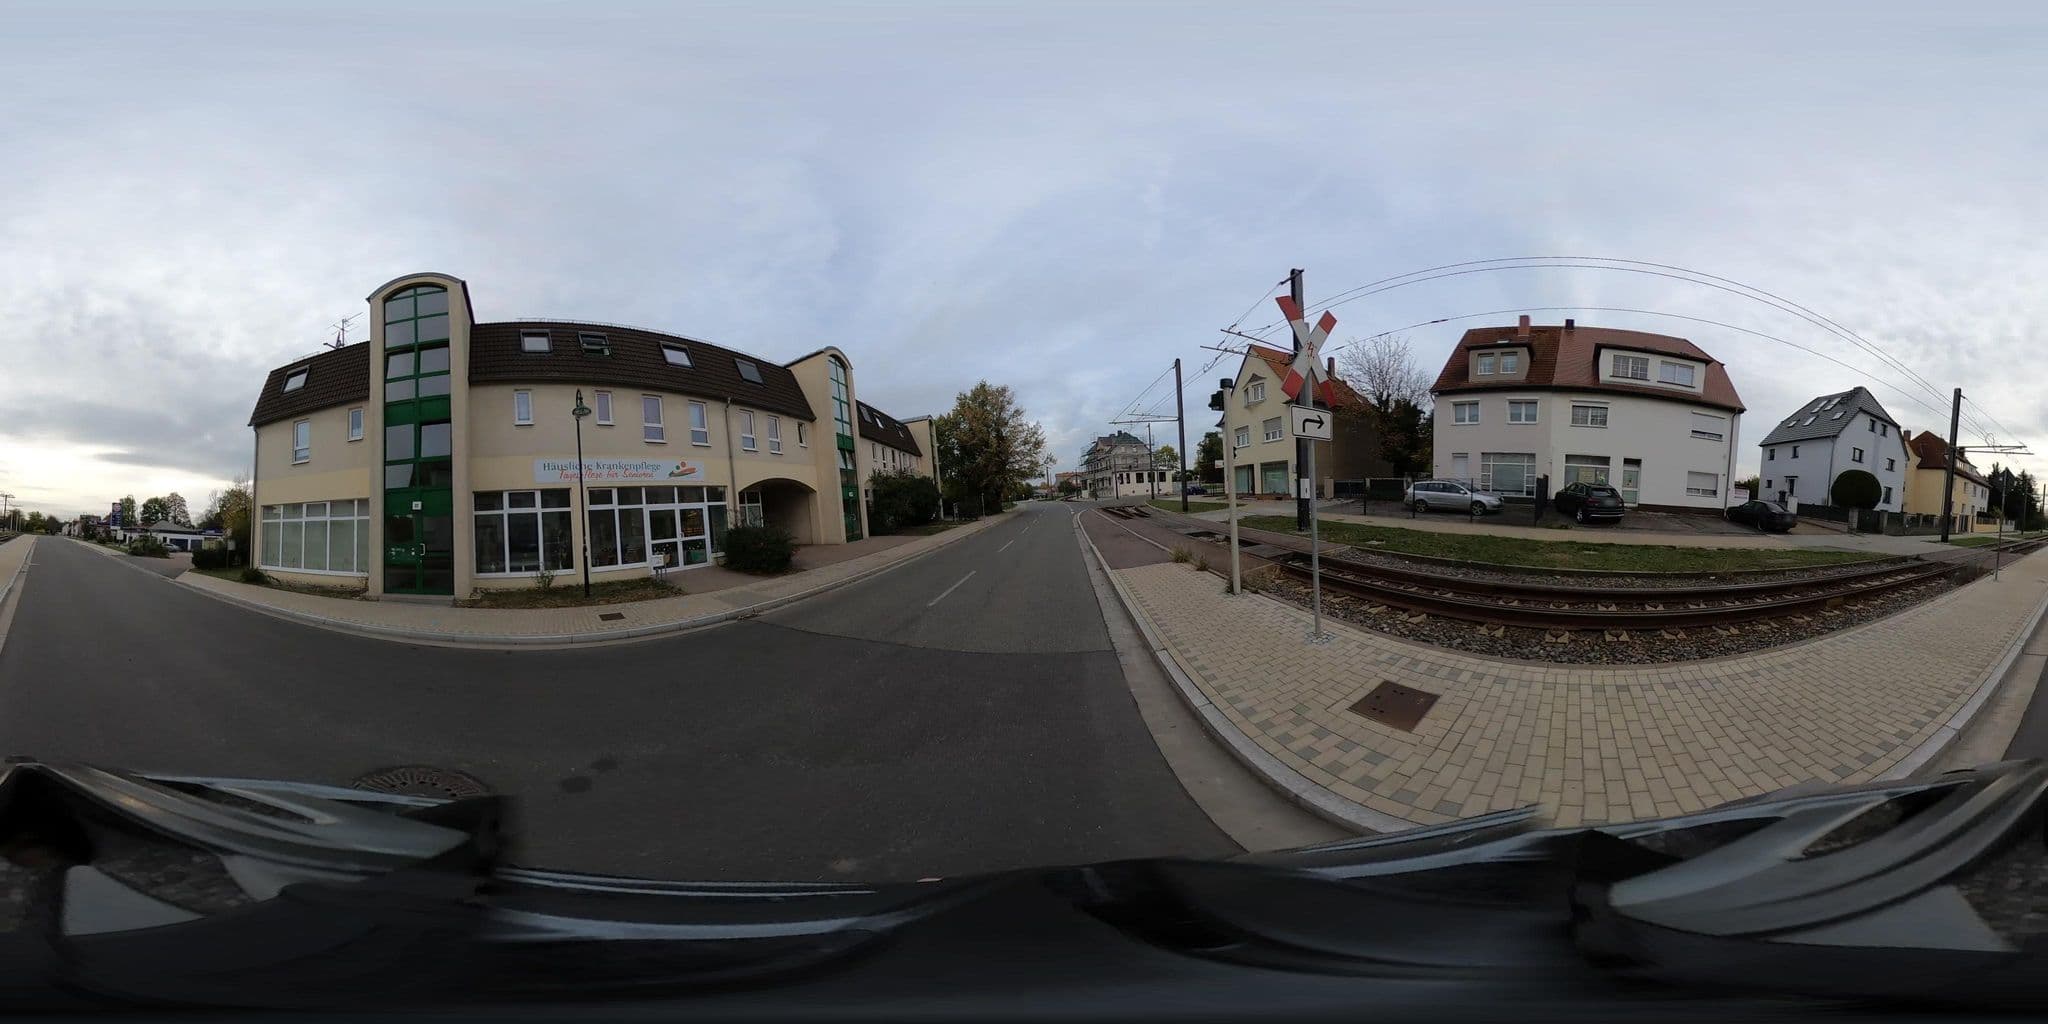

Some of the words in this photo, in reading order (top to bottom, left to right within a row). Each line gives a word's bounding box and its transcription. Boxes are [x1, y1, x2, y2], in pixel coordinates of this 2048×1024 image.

[596, 461, 662, 471] Krankenpflege
[559, 469, 603, 480] Tagesflege
[623, 468, 654, 478] Senioren
